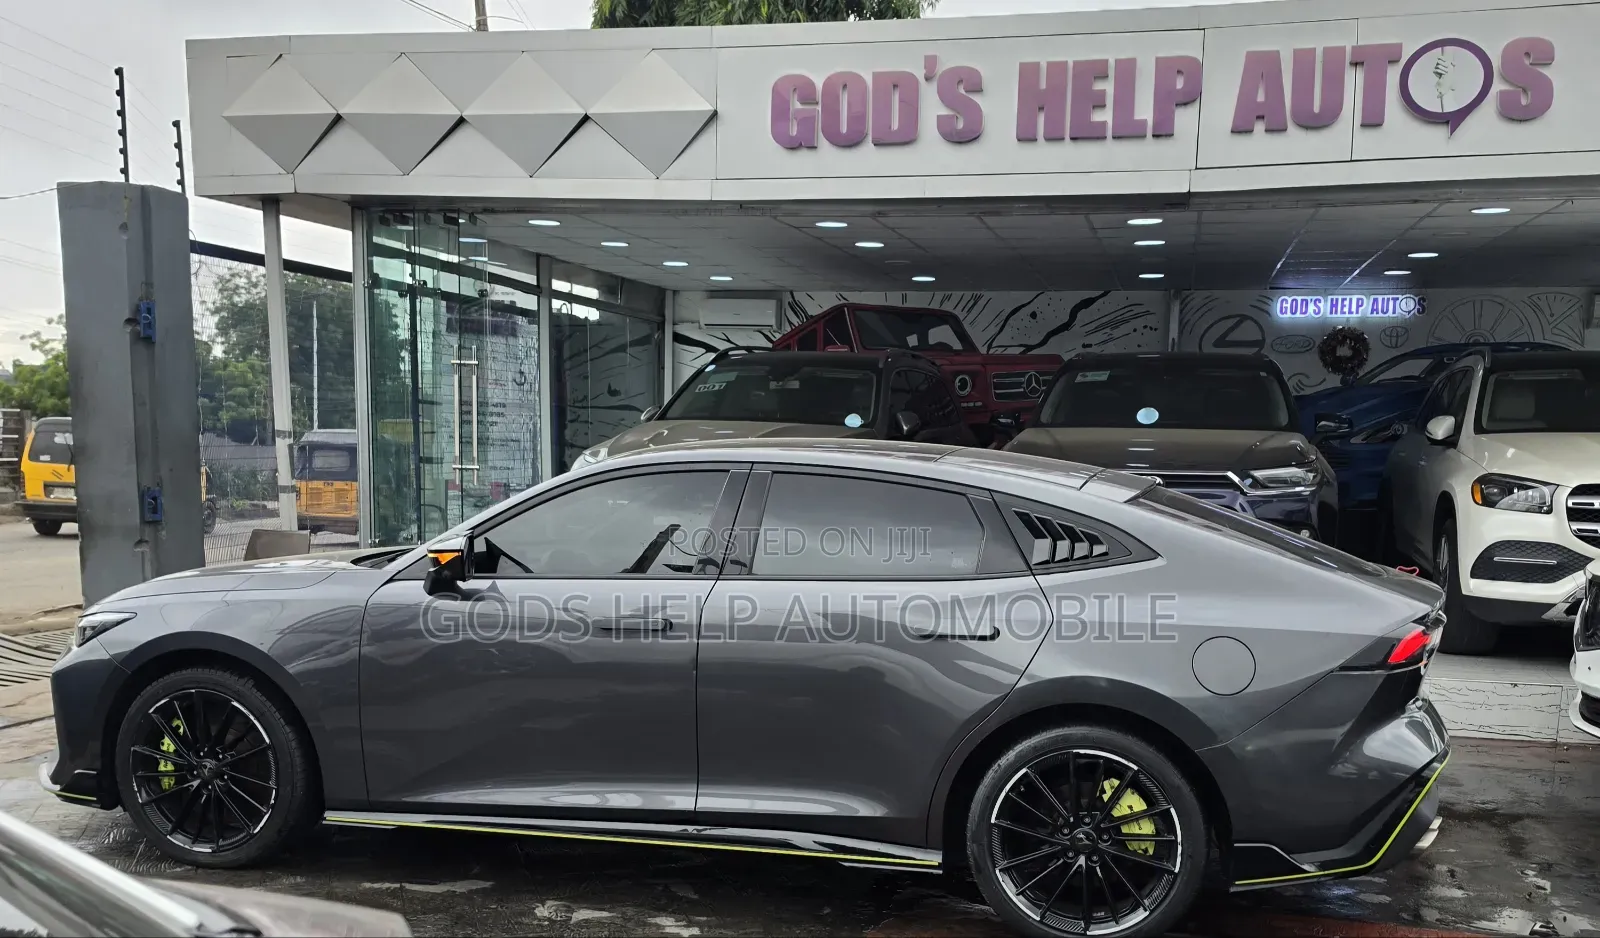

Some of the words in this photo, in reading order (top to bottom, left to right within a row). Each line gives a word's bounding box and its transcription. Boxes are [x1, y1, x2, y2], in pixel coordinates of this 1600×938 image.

[771, 55, 984, 149] GOD'S
[1017, 57, 1202, 141] HELP
[1231, 37, 1555, 138] AUTOS
[1279, 298, 1322, 315] GOD'S
[1329, 297, 1364, 315] HELP
